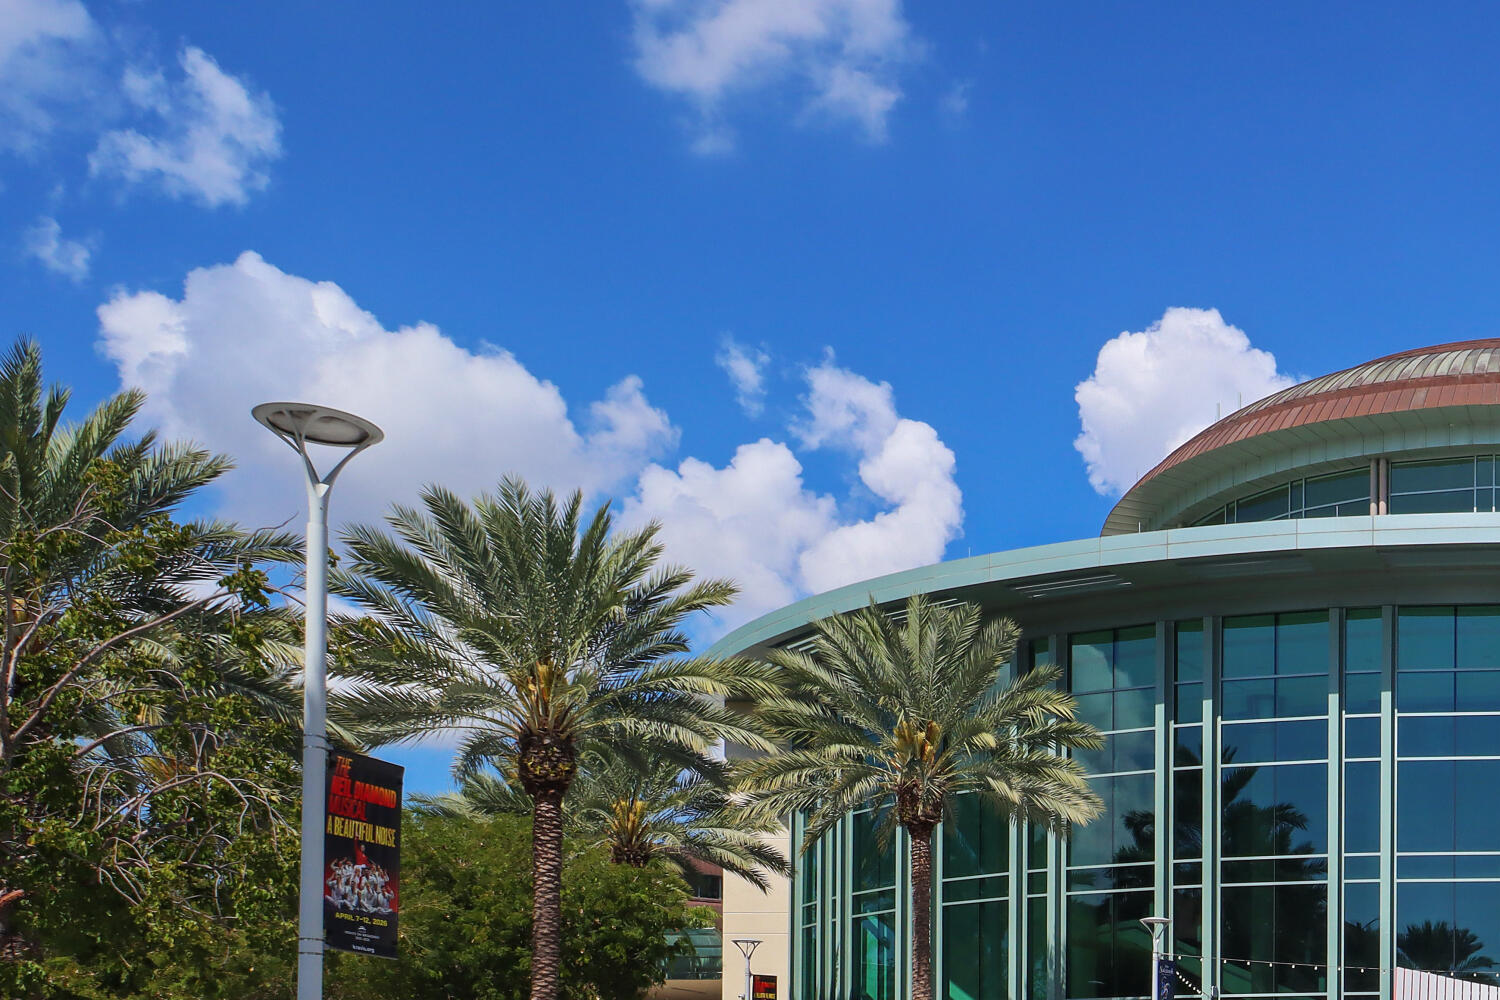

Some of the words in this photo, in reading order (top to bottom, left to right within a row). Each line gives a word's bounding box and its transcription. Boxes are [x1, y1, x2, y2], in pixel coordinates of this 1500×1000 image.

[335, 756, 353, 778] THE
[331, 775, 353, 798] NEIL
[353, 780, 397, 809] DIAMOND
[327, 795, 368, 821] MUSICAL
[326, 815, 333, 834] A
[333, 815, 375, 843] BEAUTIFUL
[375, 825, 396, 848] NOISE
[335, 912, 354, 921] APRIL
